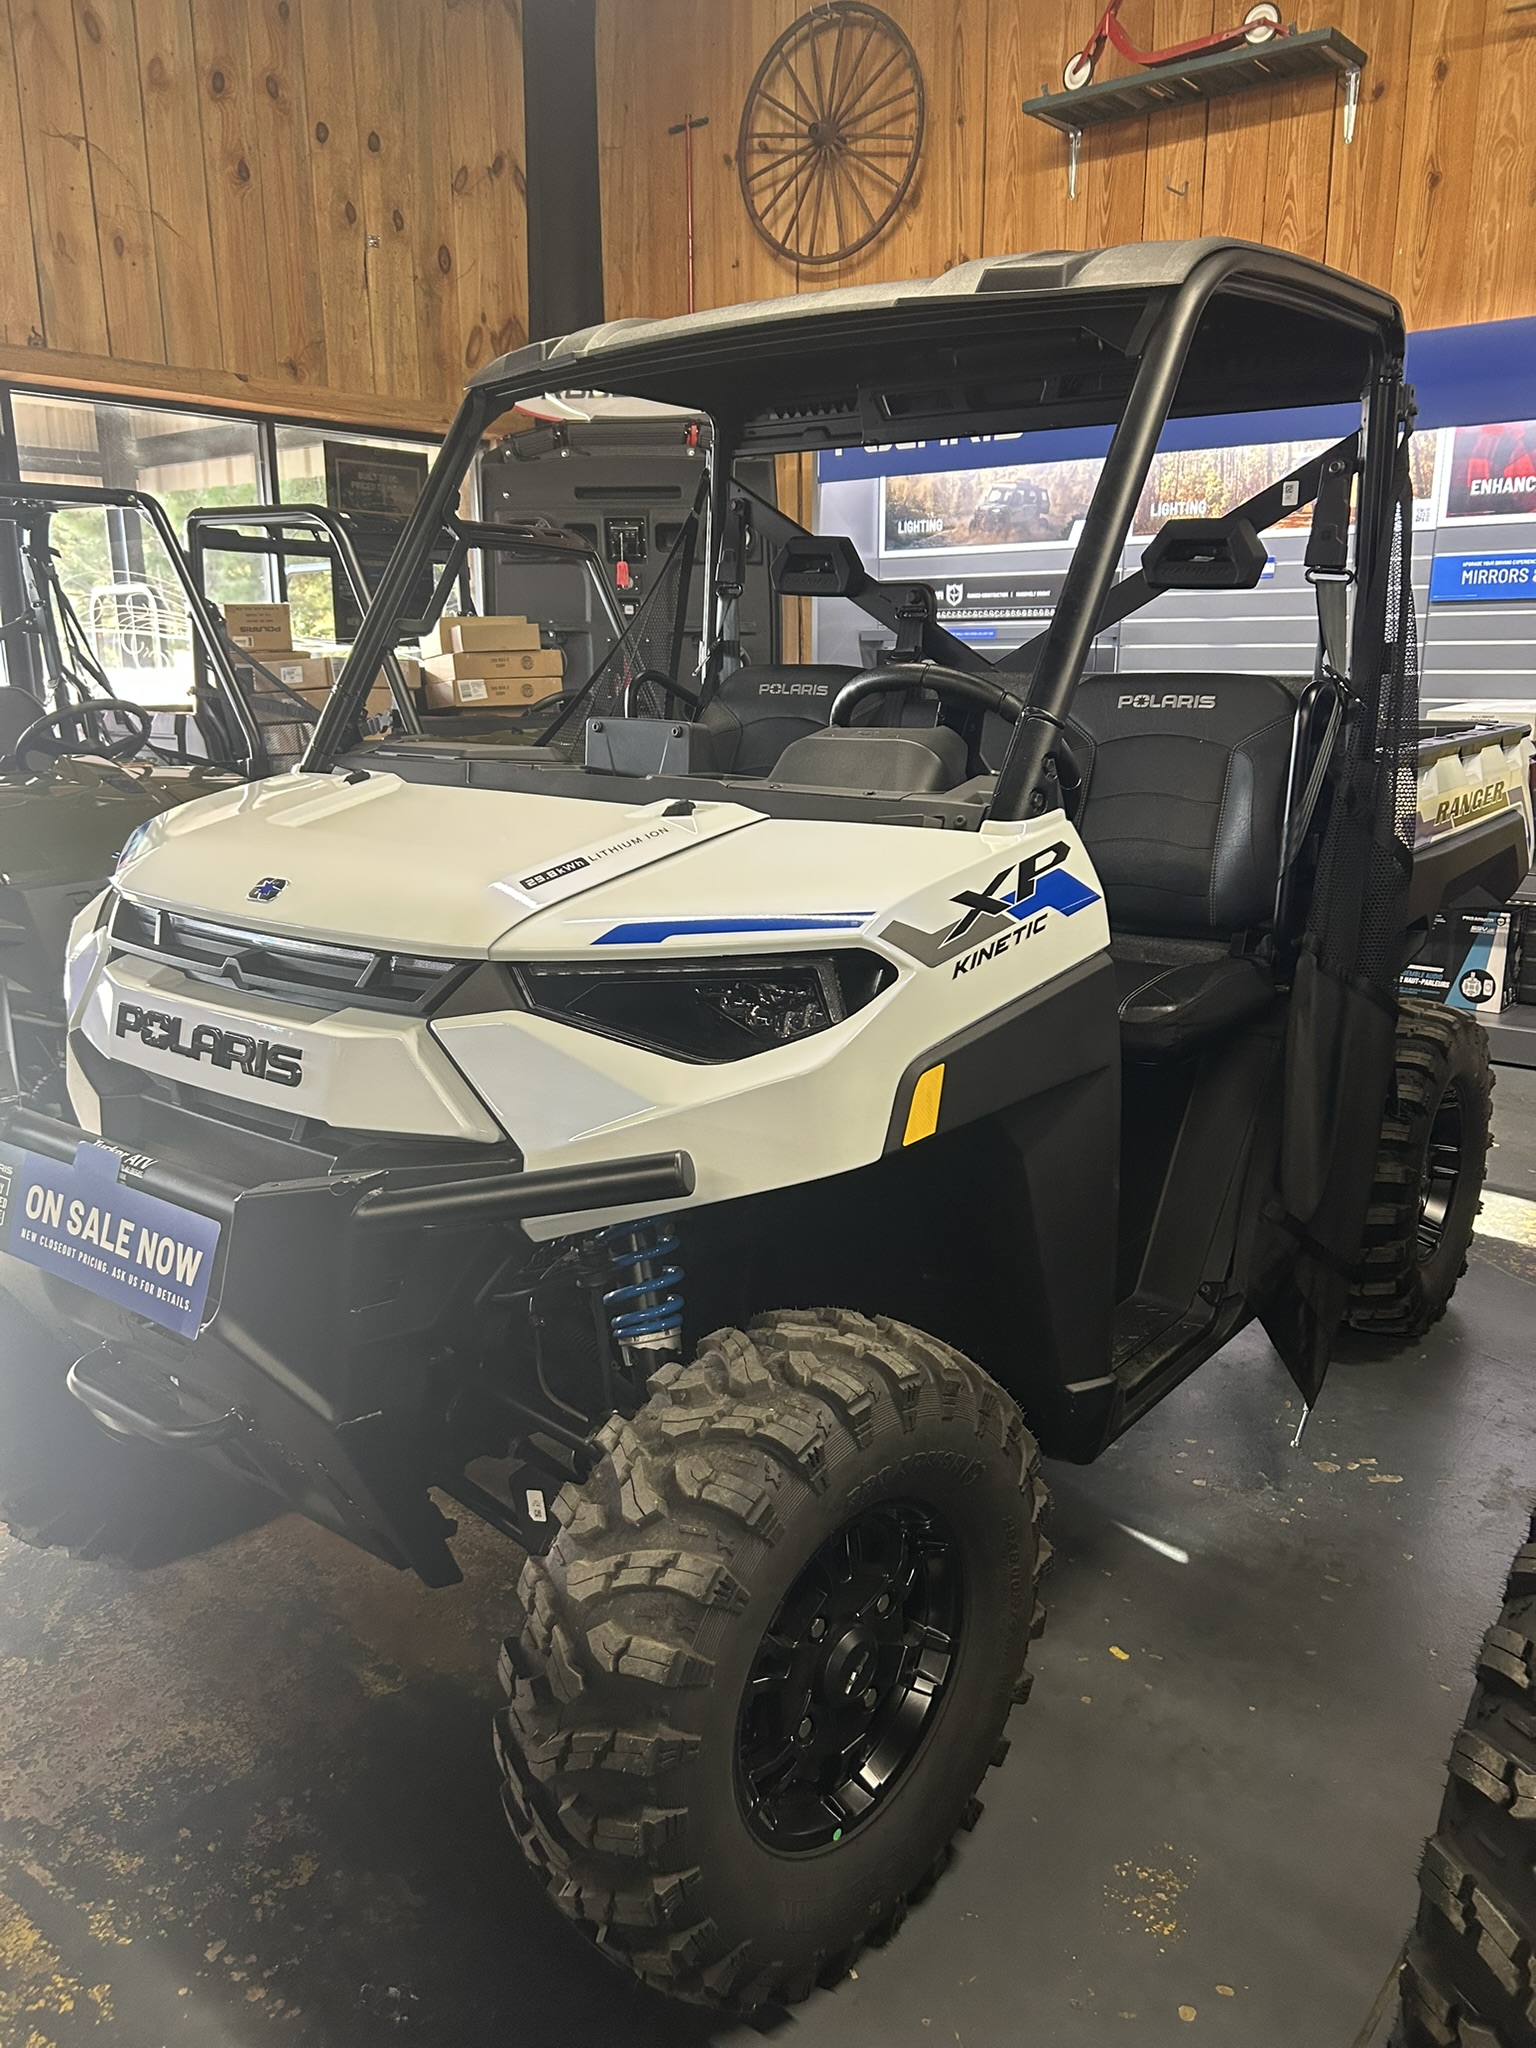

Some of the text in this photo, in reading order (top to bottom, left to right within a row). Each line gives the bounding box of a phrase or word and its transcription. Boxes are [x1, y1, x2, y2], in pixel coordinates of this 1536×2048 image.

[1150, 498, 1207, 517] LIGHTING
[897, 518, 943, 534] LIGHTING
[1461, 567, 1529, 585] MIRRORS
[240, 625, 281, 633] POLARIS
[758, 683, 829, 696] POLARIS
[1117, 694, 1217, 709] POLARIS
[1433, 780, 1505, 825] RANGER
[524, 826, 670, 888] 29.8kWh LITHIUM ION
[943, 840, 1072, 945] XP
[951, 912, 1049, 981] KINETIC
[115, 1001, 303, 1088] POLARIS
[124, 1152, 160, 1170] ATV
[25, 1184, 65, 1229] ON
[66, 1199, 136, 1259] SALE
[135, 1226, 204, 1287] NOW
[20, 1227, 192, 1313] NEW CLOSEOUT PRICING. ASK US FOR DETAILS.
